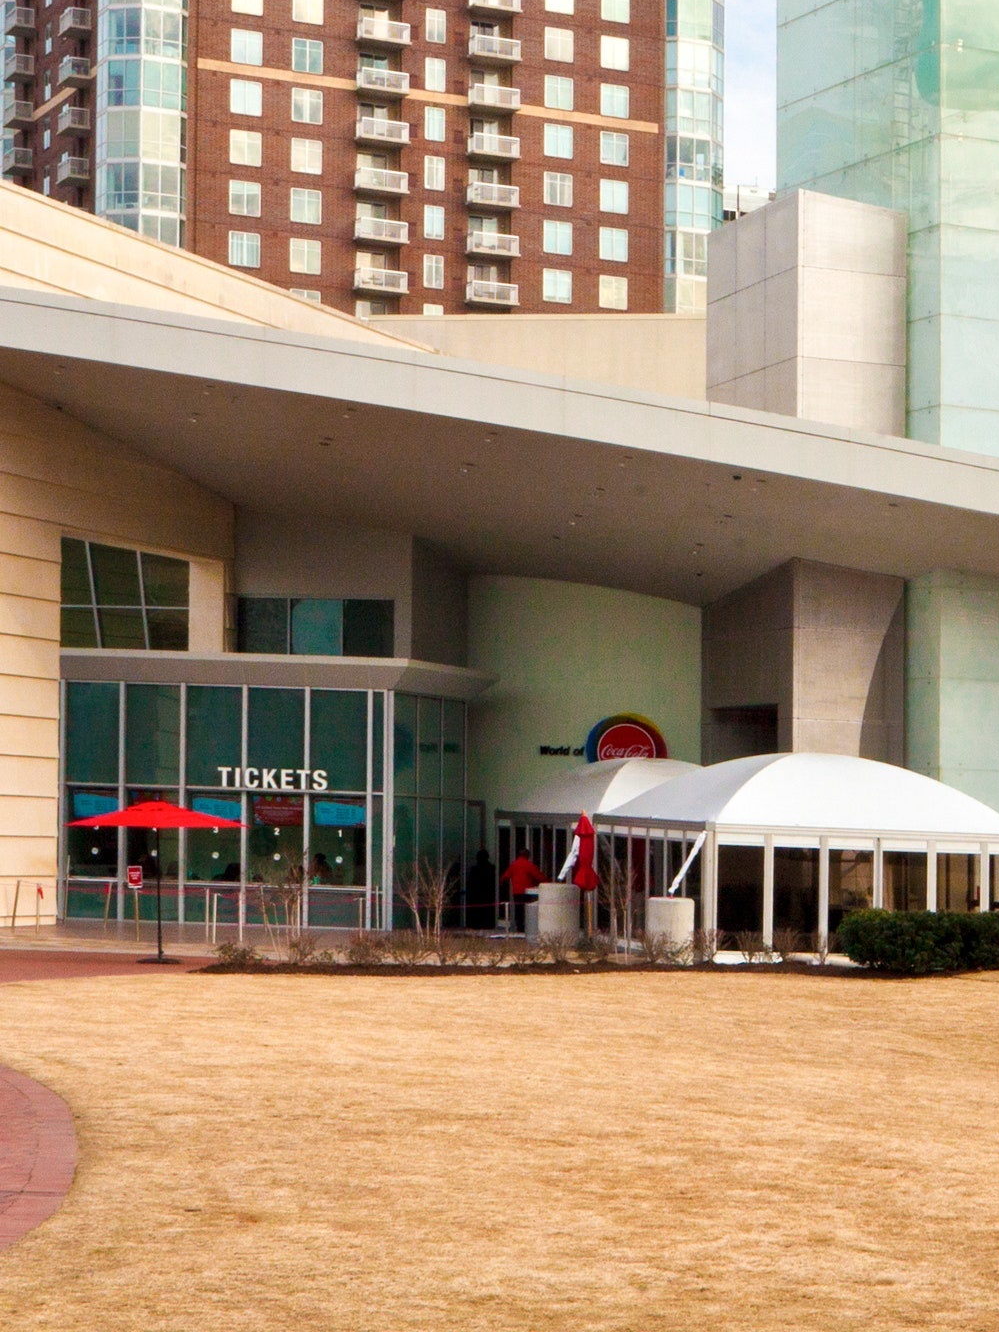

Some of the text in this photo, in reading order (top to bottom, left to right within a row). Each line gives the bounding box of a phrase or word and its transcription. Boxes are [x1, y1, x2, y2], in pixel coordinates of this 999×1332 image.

[540, 746, 569, 755] World
[573, 747, 585, 756] of
[217, 767, 328, 790] TICKETS
[273, 827, 280, 836] 2
[337, 829, 343, 838] 1
